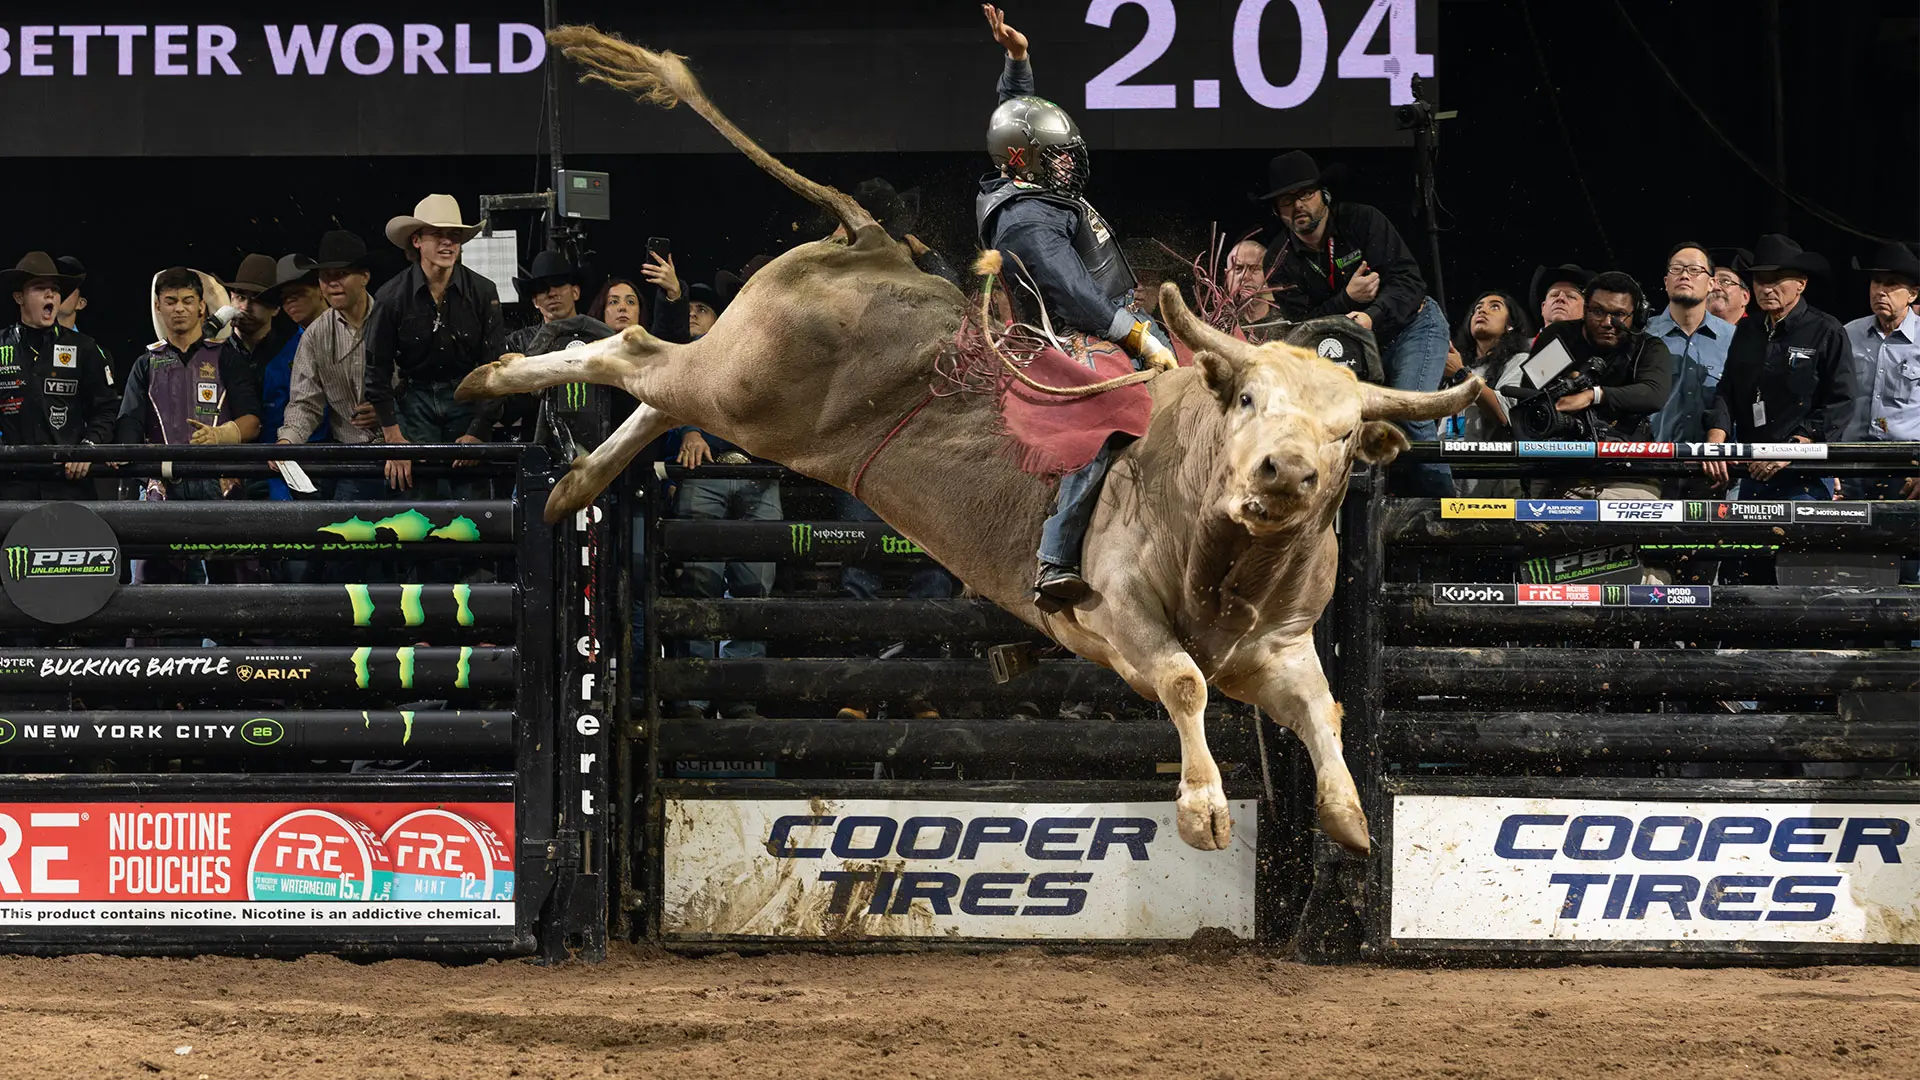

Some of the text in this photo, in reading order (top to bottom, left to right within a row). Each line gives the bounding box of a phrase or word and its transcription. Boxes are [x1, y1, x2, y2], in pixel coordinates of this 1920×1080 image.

[0, 23, 546, 75] ETTER WORLD
[1084, 0, 1435, 109] 2.04
[47, 382, 76, 392] YETI
[1445, 441, 1512, 452] BOOT BARN
[1601, 442, 1671, 453] LUCAS OIL
[1685, 442, 1744, 456] YETI
[1771, 445, 1822, 454] Texas Capital
[1607, 502, 1674, 510] COOPER
[1731, 503, 1785, 516] PENDLETON
[1616, 510, 1663, 519] TIRES
[813, 529, 866, 539] MONSTER
[31, 566, 71, 574] UNLEASH
[1555, 568, 1594, 581] UNLEASH
[1606, 560, 1633, 570] BEAST
[1442, 586, 1504, 601] Kubota
[1529, 585, 1563, 600] FRE
[1566, 585, 1589, 593] NICOTINE
[1566, 592, 1590, 600] POUCHES
[1667, 587, 1691, 596] MODO
[1667, 595, 1696, 604] CASINO
[40, 656, 231, 678] BUCKING BATTLE
[253, 668, 311, 679] ARIAT
[23, 725, 236, 738] NEW YORK CITY
[252, 727, 272, 737] 26
[109, 812, 232, 850] NICOTINE
[767, 815, 1158, 861] COOPER
[1493, 814, 1910, 864] COOPER
[275, 831, 346, 873] FRE
[397, 831, 466, 872] FRE
[109, 856, 231, 894] POUCHES
[280, 878, 337, 897] WATERMELON
[338, 872, 355, 899] 15
[414, 878, 446, 896] MINT
[459, 872, 476, 899] 12
[817, 871, 1095, 916] TIRES
[1549, 873, 1842, 922] TIRES
[0, 908, 501, 922] This product contains nicotine. Nicotine is an addictive chemical.
